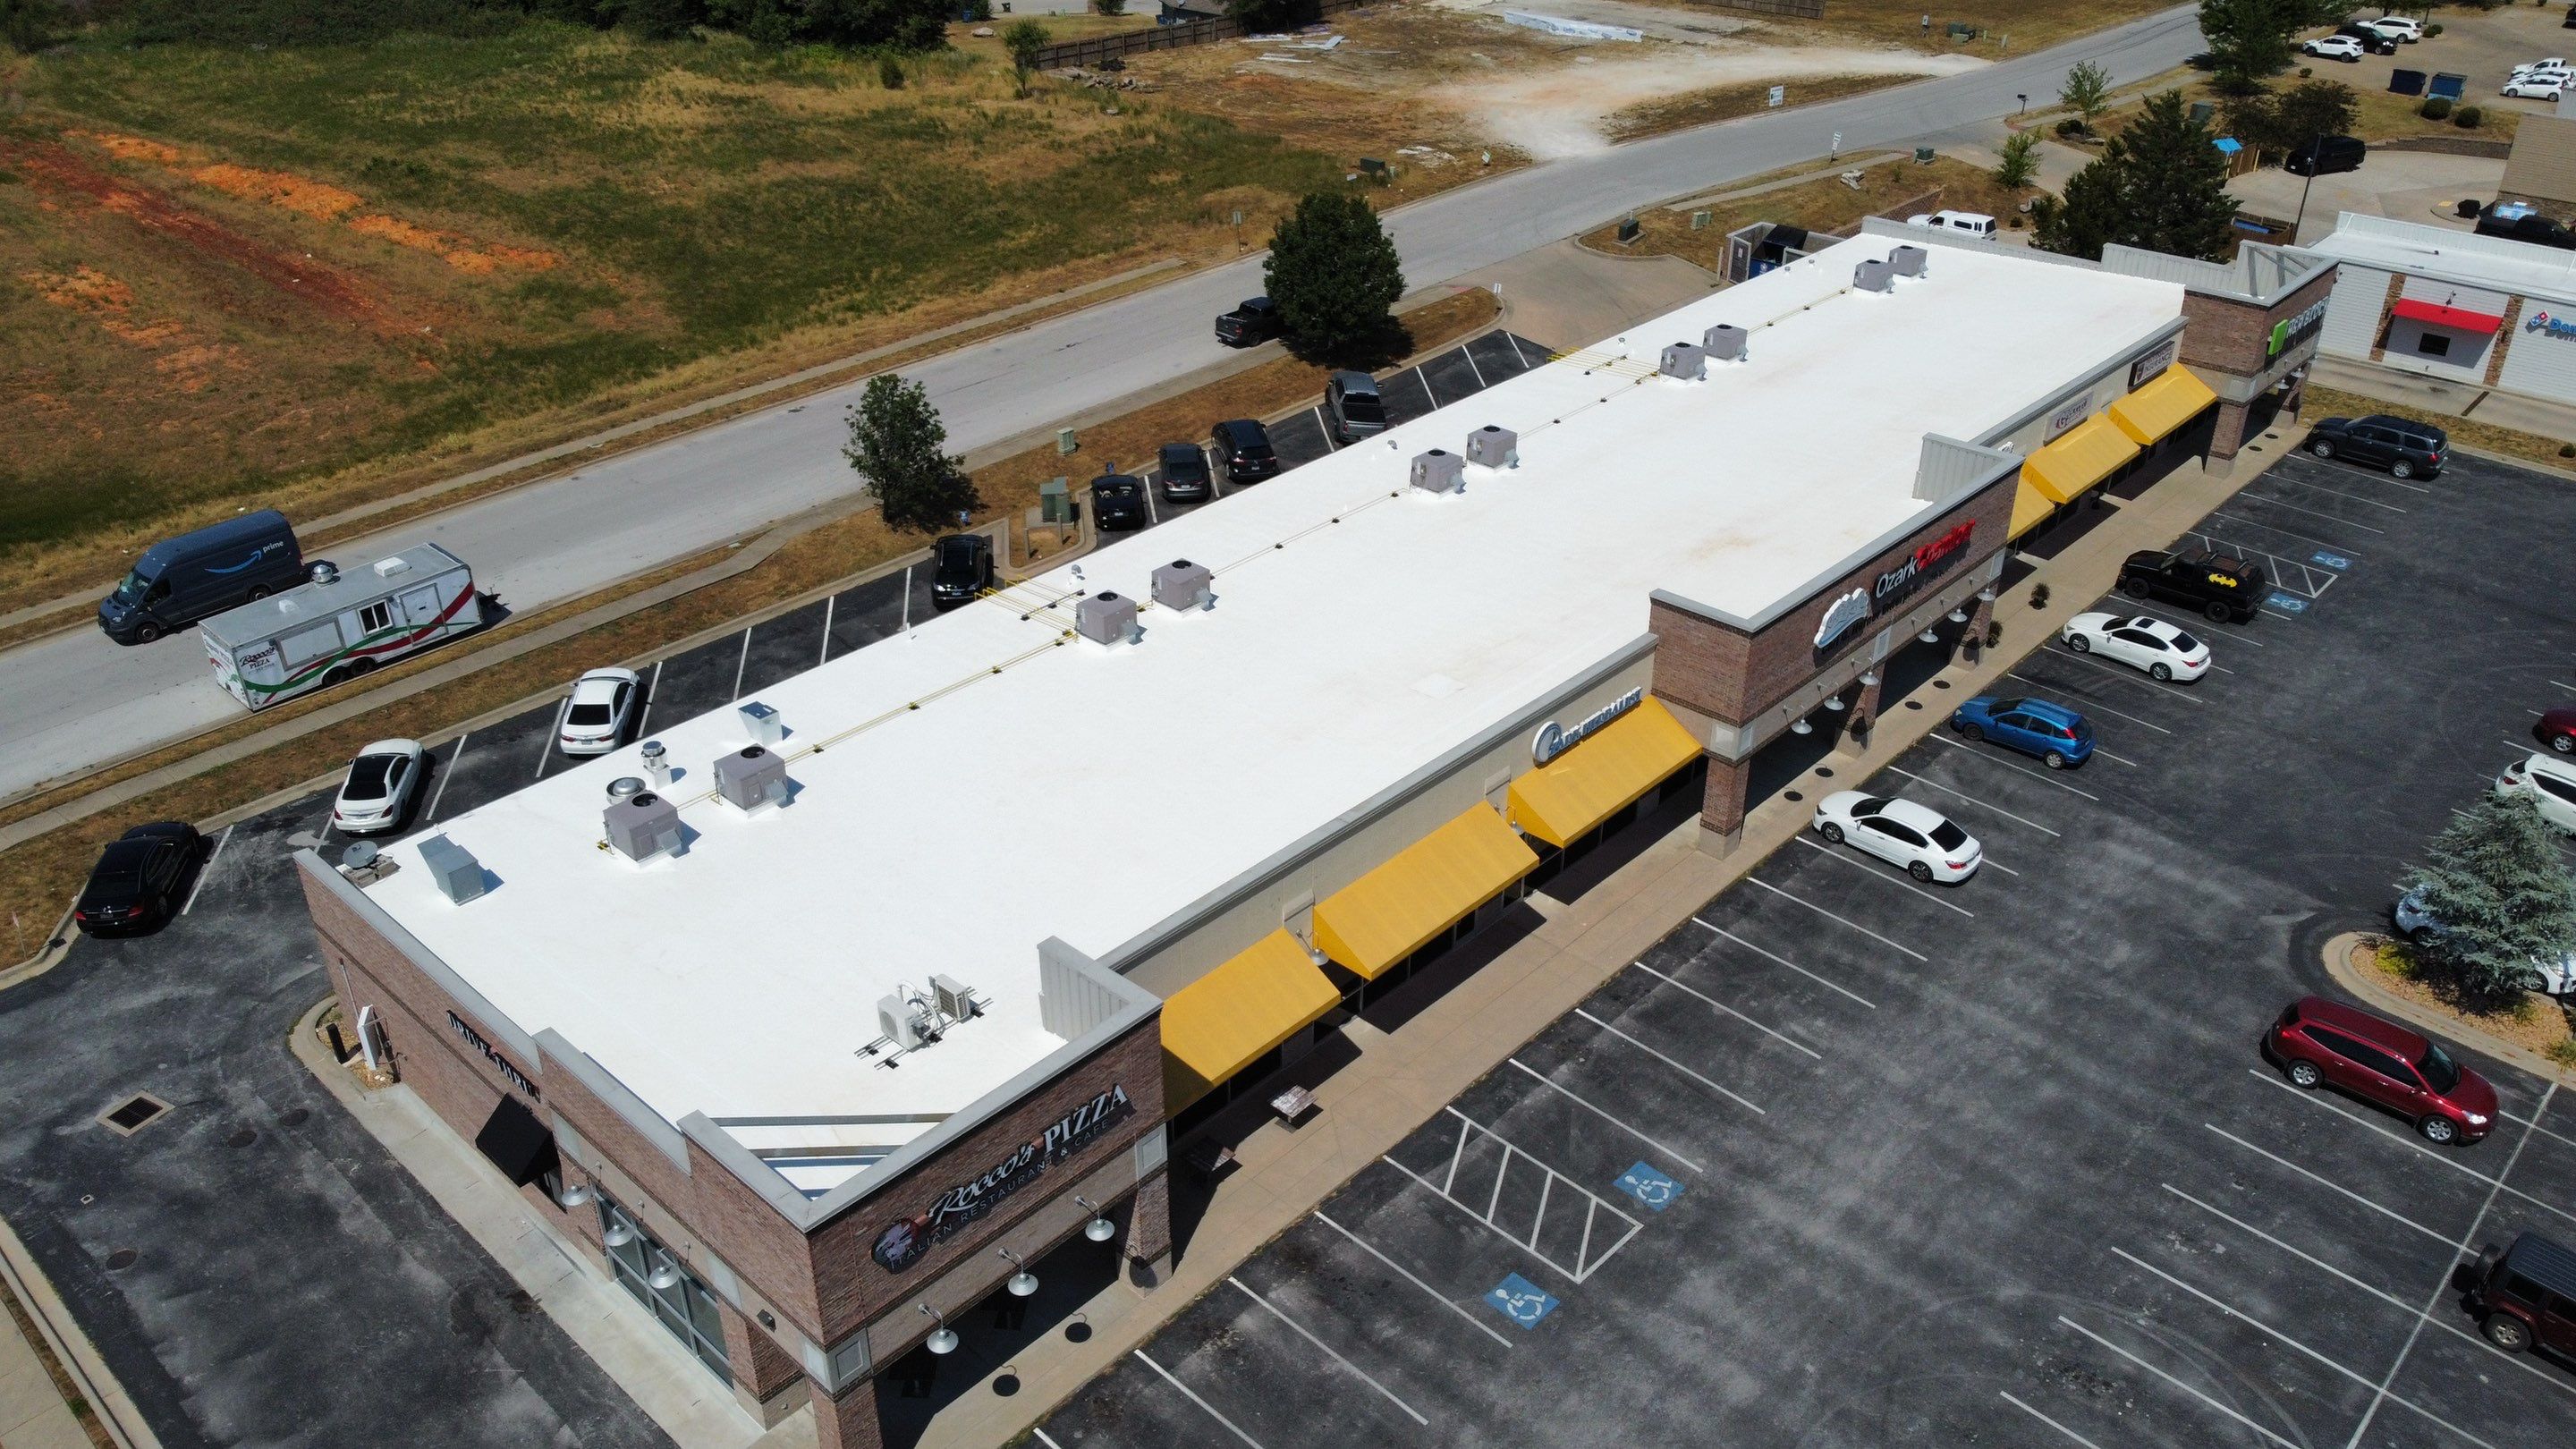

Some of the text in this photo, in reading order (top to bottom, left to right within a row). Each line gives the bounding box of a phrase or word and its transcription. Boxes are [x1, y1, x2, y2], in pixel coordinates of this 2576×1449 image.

[262, 540, 284, 553] prime
[1876, 555, 1918, 598] Ozark
[250, 658, 270, 669] PIZZA
[446, 1010, 489, 1057] DRIVE
[1043, 1084, 1129, 1154] PIZZA
[892, 1224, 953, 1270] ITALIAN
[961, 1155, 1054, 1220] RESTAURANT
[1060, 1147, 1069, 1157] &
